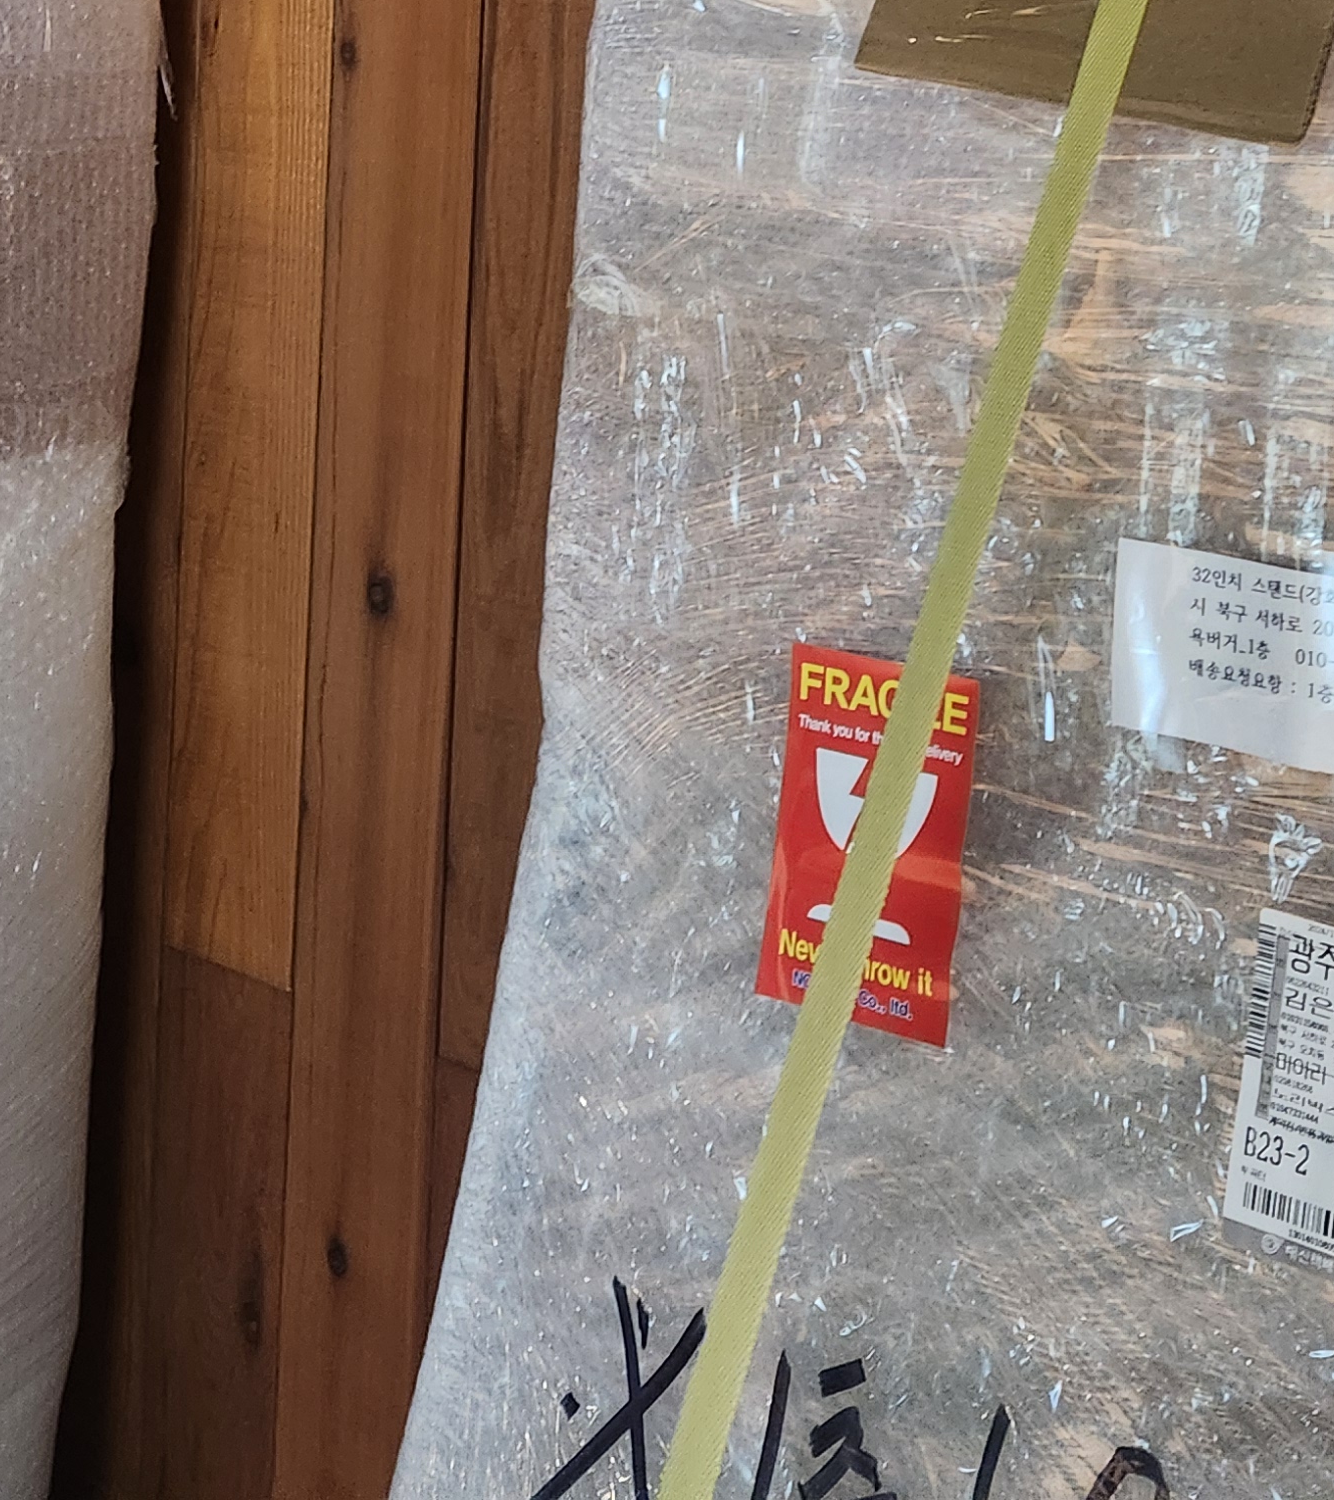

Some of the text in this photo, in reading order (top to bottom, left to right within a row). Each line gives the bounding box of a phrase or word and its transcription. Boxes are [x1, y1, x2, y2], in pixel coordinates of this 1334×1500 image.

[1191, 566, 1243, 592] 32인치
[1189, 597, 1207, 617] 시
[1216, 601, 1249, 624] 북구
[1255, 609, 1304, 634] 서하로
[798, 713, 832, 737] Thank
[832, 721, 854, 741] you
[854, 725, 871, 742] for
[924, 743, 964, 767] elivery
[777, 927, 821, 964] Nev
[917, 966, 934, 998] it
[888, 997, 915, 1021] ltd.
[1243, 1125, 1312, 1177] B23-2
